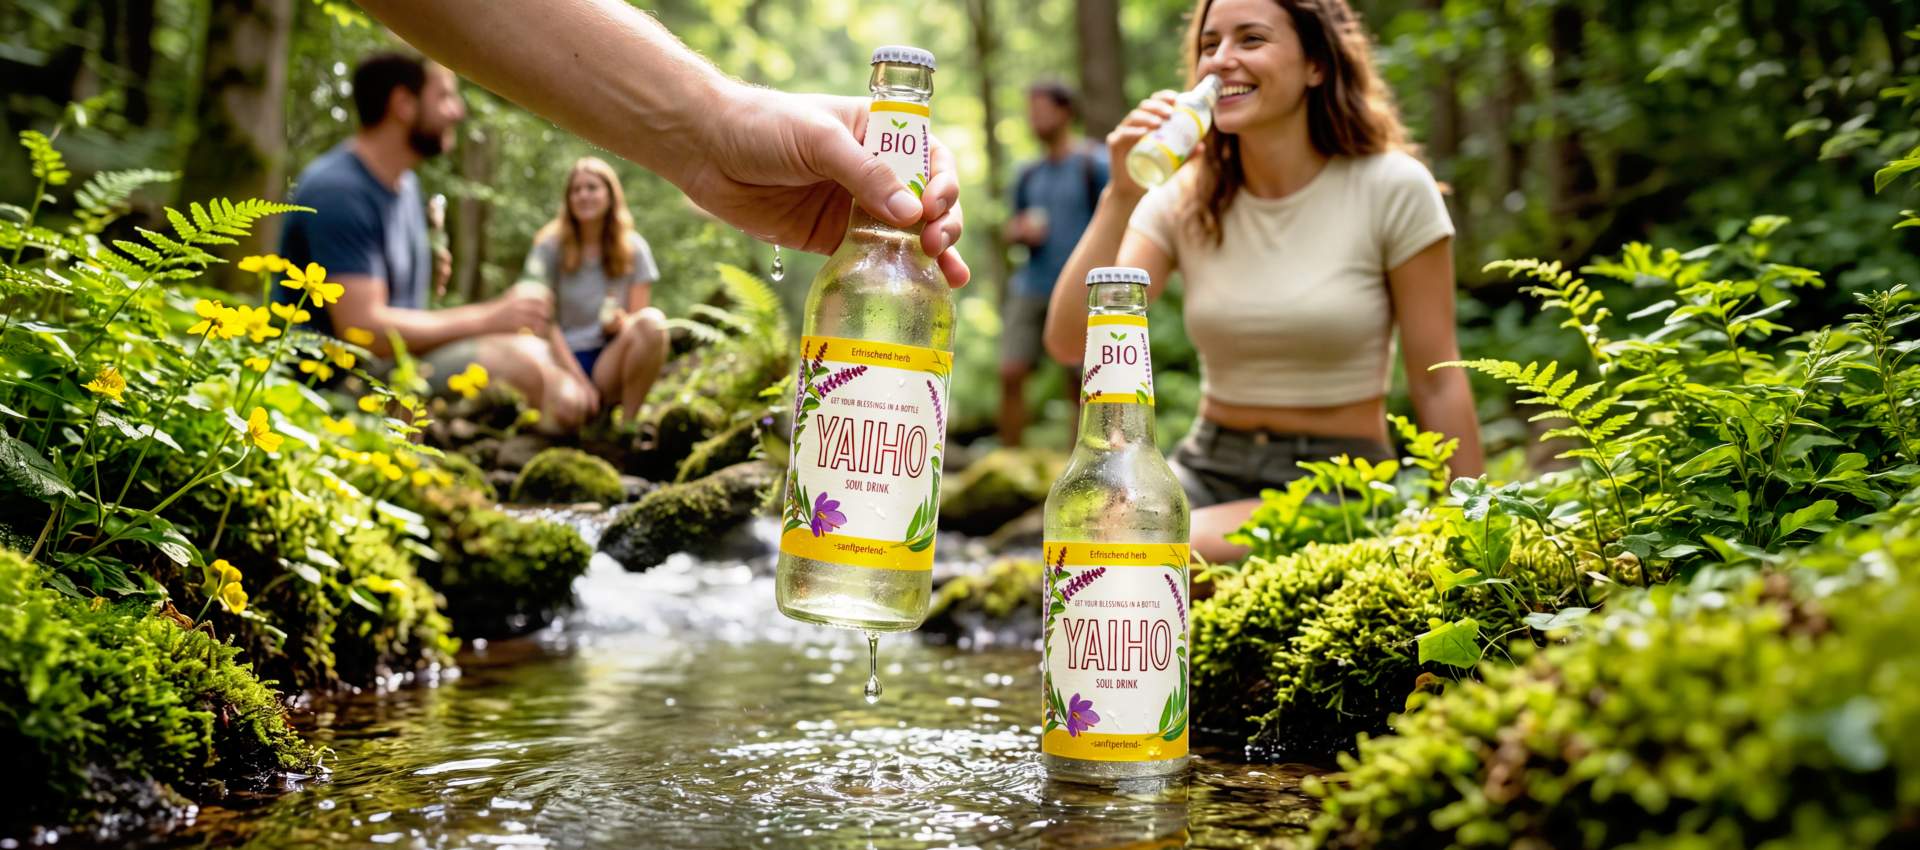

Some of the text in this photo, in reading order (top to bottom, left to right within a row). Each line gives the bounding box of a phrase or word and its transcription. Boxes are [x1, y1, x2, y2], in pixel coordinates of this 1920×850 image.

[880, 132, 916, 155] BIO
[894, 352, 911, 363] herb
[1102, 345, 1137, 365] BIO
[831, 396, 840, 405] GET
[841, 398, 855, 406] YOUR
[856, 399, 886, 410] BLESSINGS
[900, 404, 919, 414] BOTTLE
[816, 414, 928, 478] YAIHO
[845, 479, 890, 494] SOUL DRINK
[1089, 550, 1147, 559] Erfrischend herb
[1074, 599, 1160, 609] GET YOUR BLESSINGS IN A BOTTLE
[1063, 617, 1172, 672] YAIHO
[1095, 678, 1138, 689] SOUL DRINK
